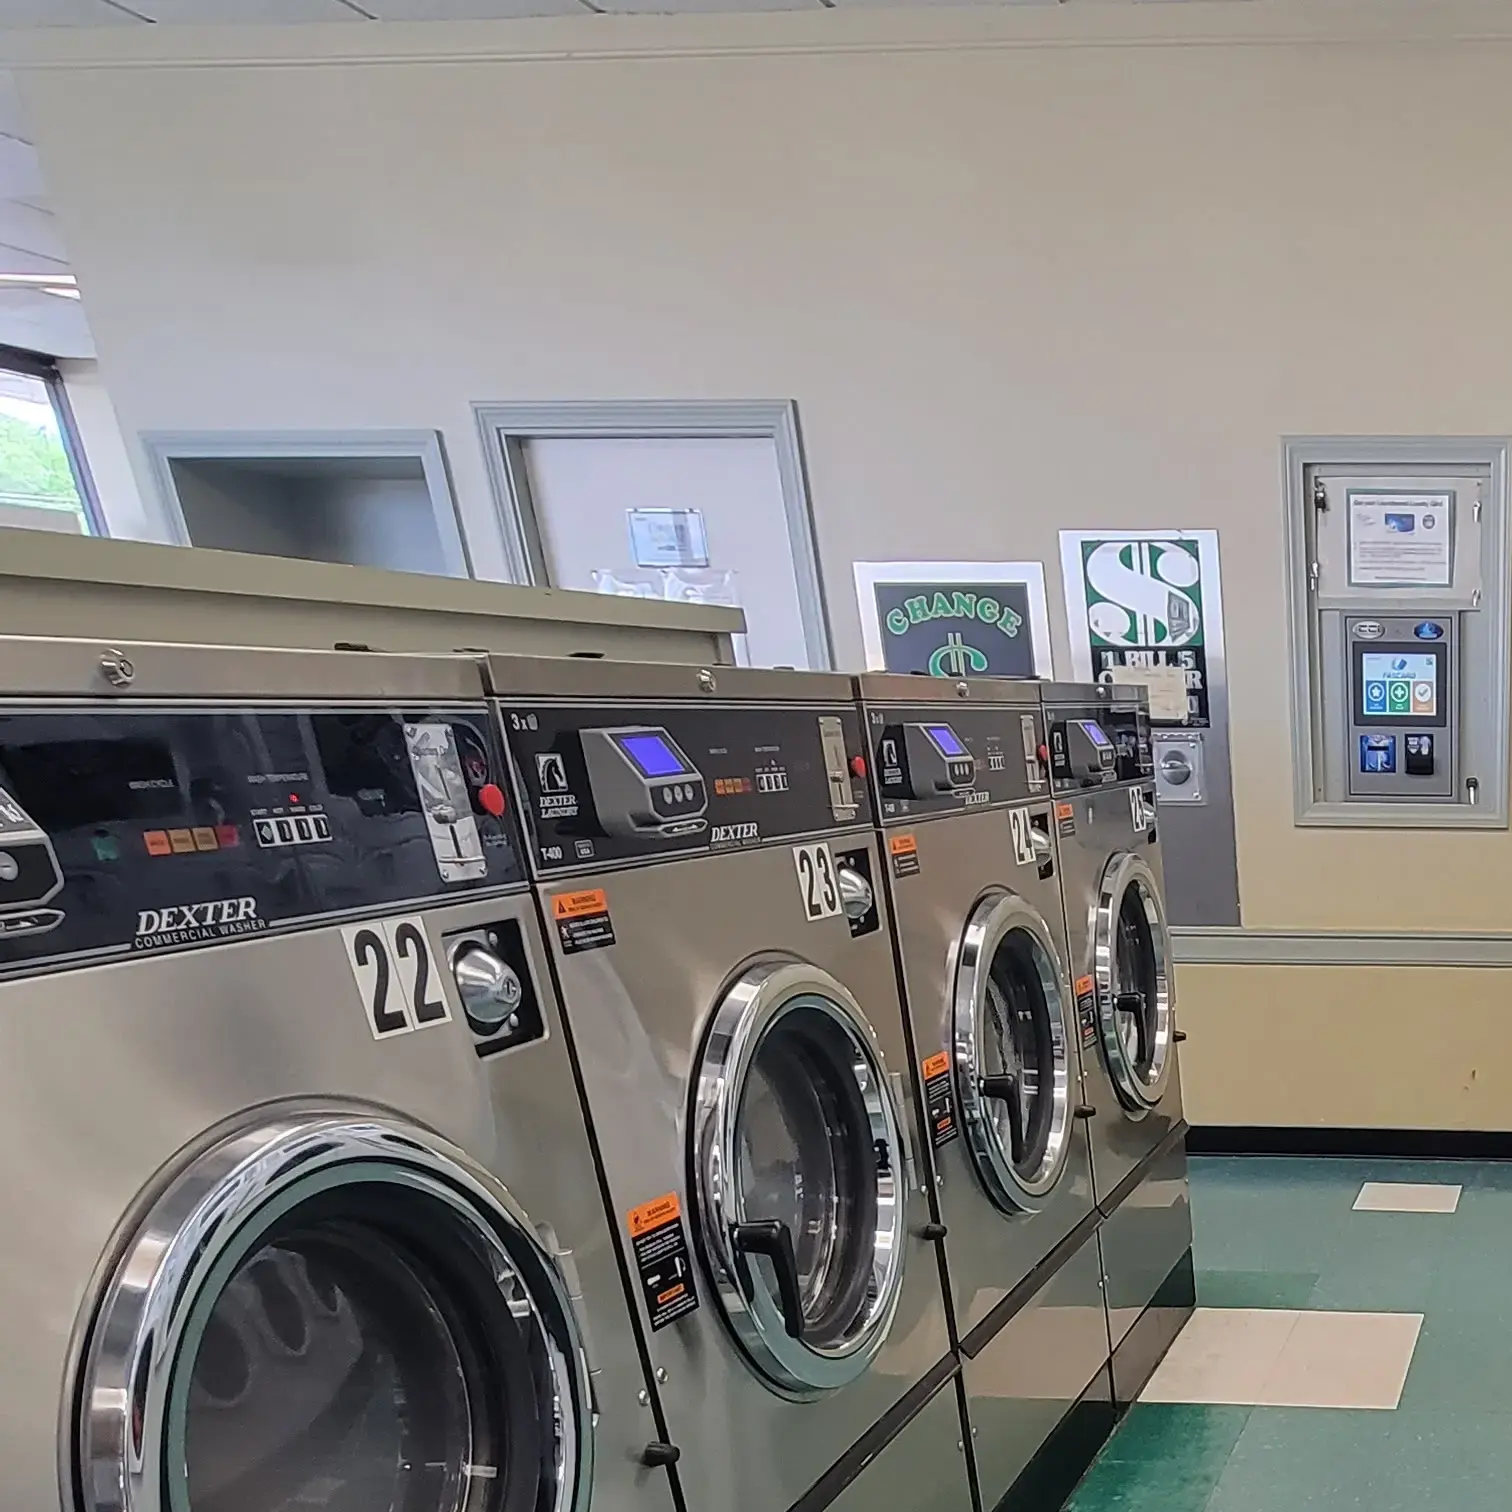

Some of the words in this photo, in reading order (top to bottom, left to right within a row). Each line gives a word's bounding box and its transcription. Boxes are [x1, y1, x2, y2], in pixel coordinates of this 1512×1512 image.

[887, 591, 1022, 638] CHANGE
[540, 795, 576, 807] DEXTER
[711, 822, 758, 842] DEXTER
[1013, 809, 1034, 861] 24
[800, 847, 836, 917] 23
[134, 927, 216, 949] COMMERCIAL
[219, 918, 267, 936] WASHER
[135, 896, 257, 936] DEXTER
[354, 923, 447, 1033] 22
